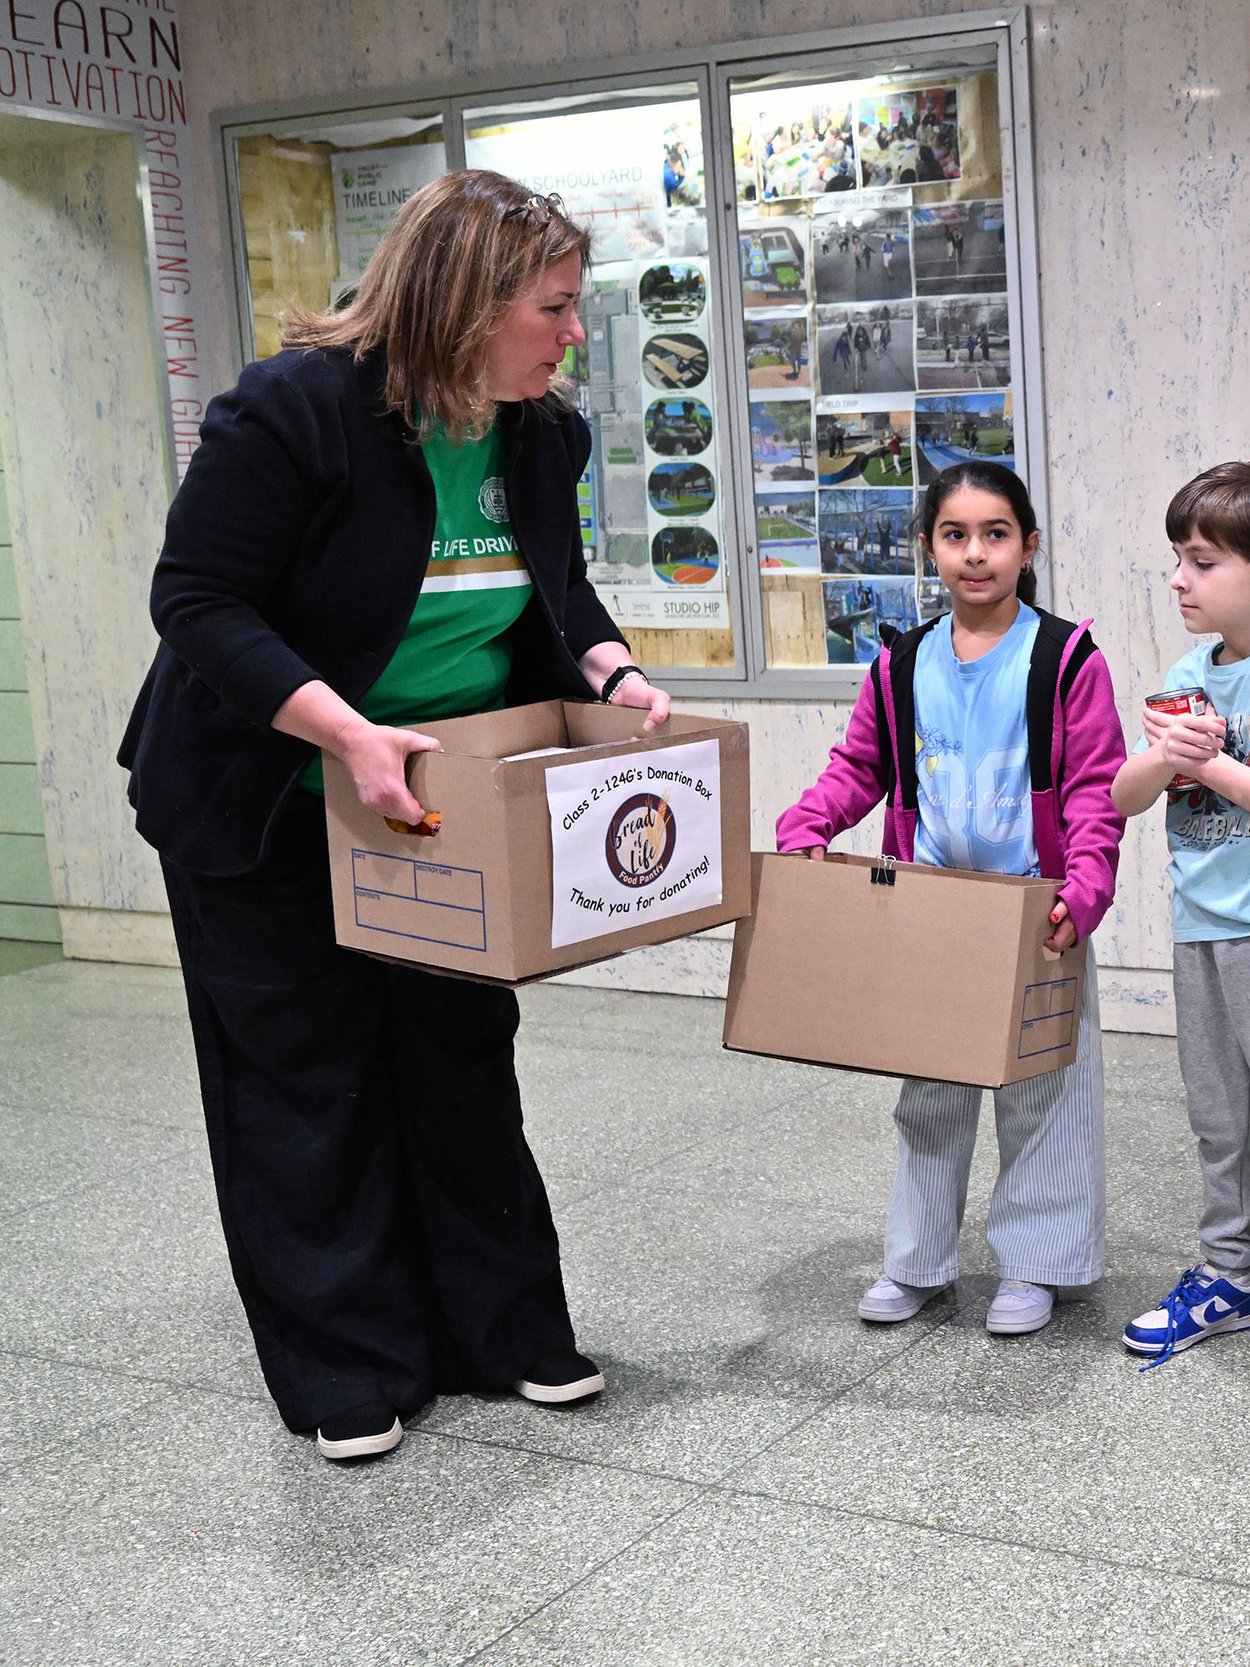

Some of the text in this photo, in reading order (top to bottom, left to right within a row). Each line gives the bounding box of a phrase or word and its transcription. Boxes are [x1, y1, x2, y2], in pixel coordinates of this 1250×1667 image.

[7, 0, 181, 72] EARN
[533, 166, 643, 191] SCHOOLYARD
[343, 187, 412, 209] TIMELINE
[163, 315, 199, 378] NEW
[473, 535, 519, 554] DRIV
[664, 602, 701, 614] STUDIO
[704, 602, 720, 613] HIP
[563, 766, 713, 830] Class 2-124G's Donation Box
[611, 798, 655, 850] Bread
[633, 832, 643, 848] of
[353, 852, 366, 861] DATE
[631, 840, 655, 874] Life
[416, 863, 452, 877] DESTROY DATE
[619, 863, 664, 885] Food Pantry
[355, 889, 381, 901] CONTENTS
[570, 855, 710, 917] Thank you for donating!
